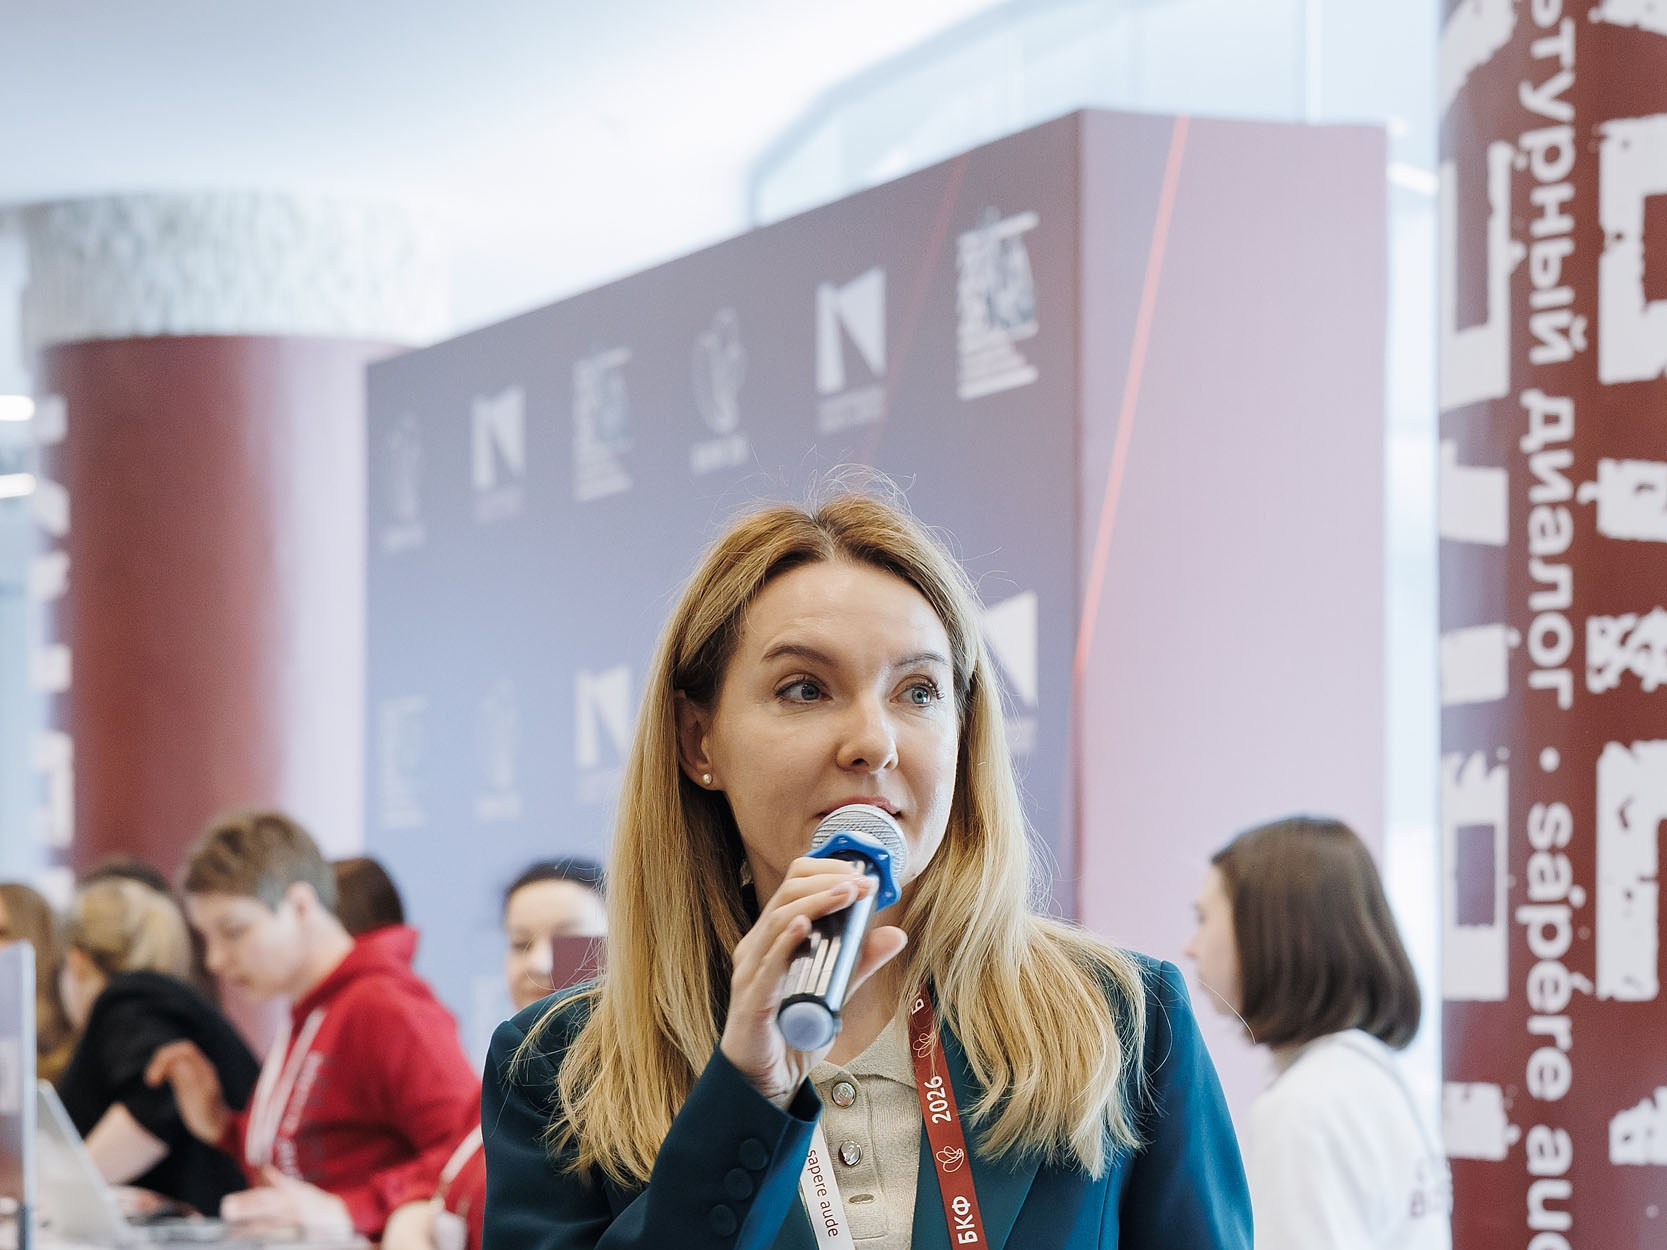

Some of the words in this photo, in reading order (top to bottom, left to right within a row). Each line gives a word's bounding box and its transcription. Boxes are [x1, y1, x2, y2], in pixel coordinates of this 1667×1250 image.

[1519, 388, 1575, 709] диалог
[924, 1075, 951, 1124] 2026
[808, 1149, 828, 1198] sapere
[820, 1200, 838, 1237] aude
[951, 1195, 978, 1244] БКФ
